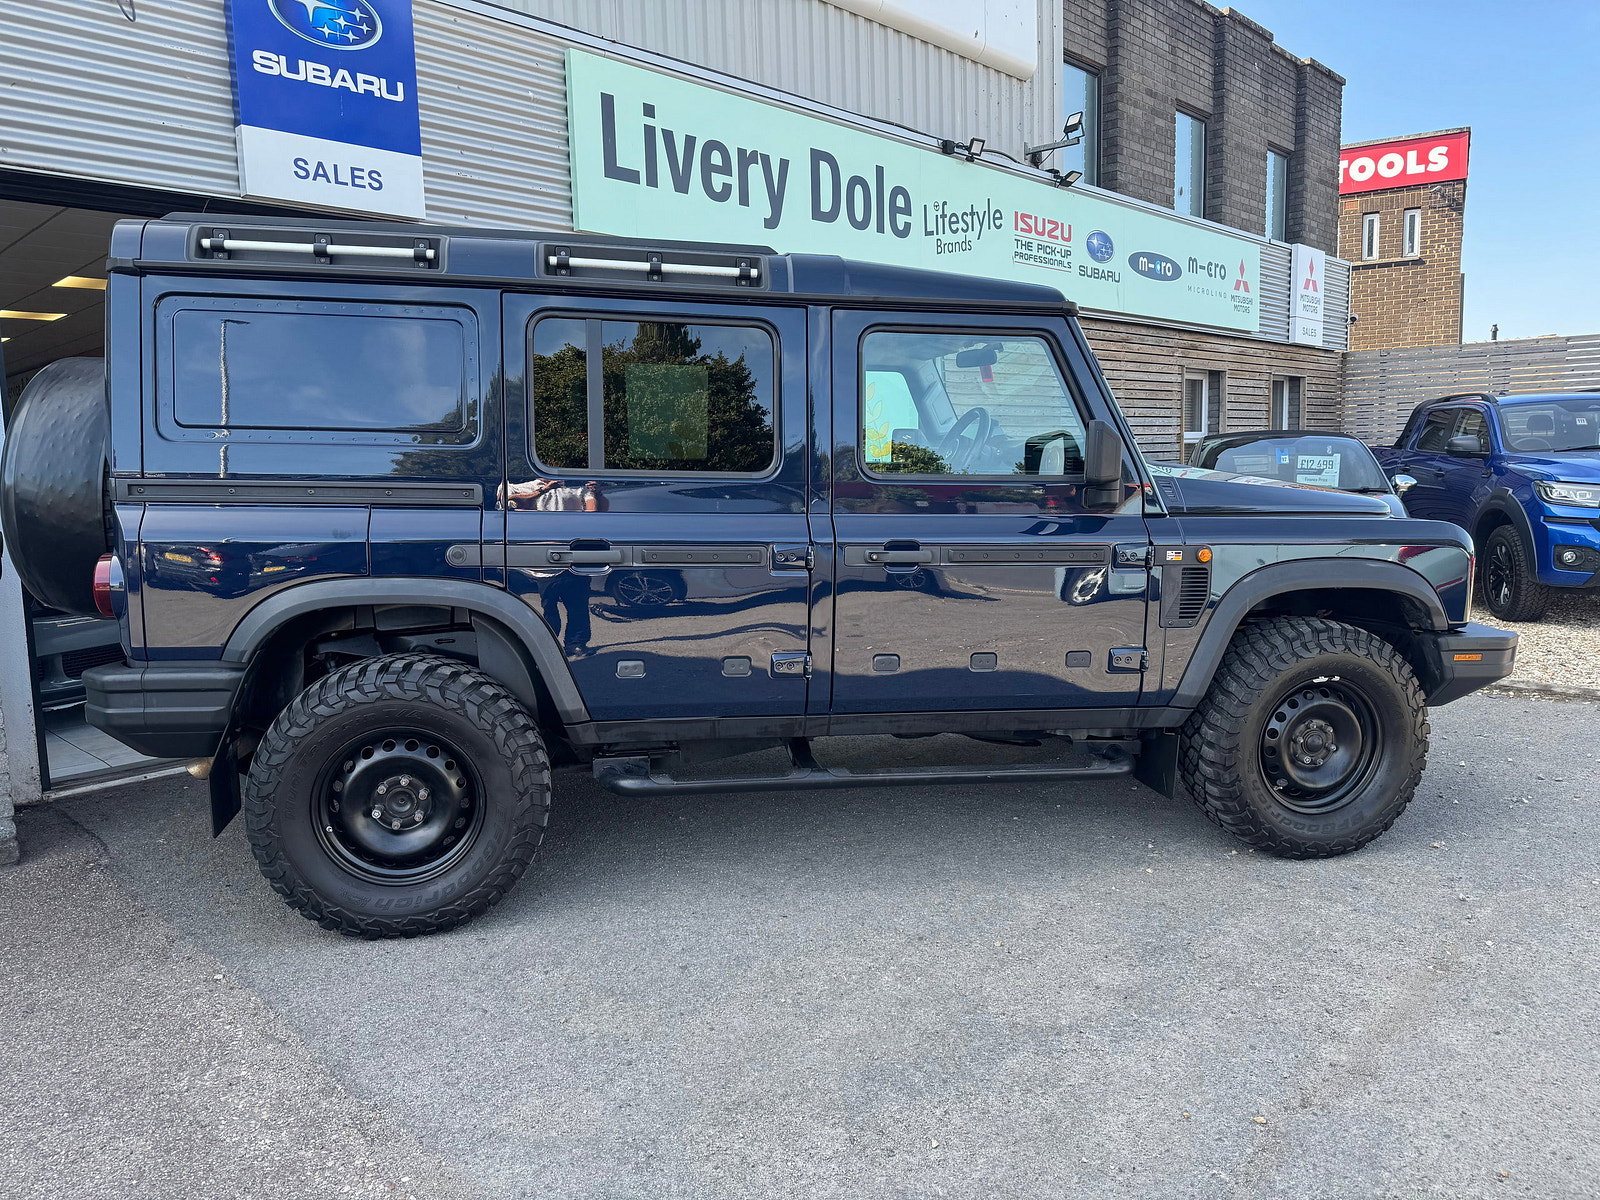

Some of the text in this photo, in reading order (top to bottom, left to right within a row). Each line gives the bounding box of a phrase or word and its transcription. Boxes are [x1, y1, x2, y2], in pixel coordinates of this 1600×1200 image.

[252, 49, 405, 102] SUBARU
[293, 156, 384, 192] SALES
[600, 92, 912, 239] Livery Dole
[923, 198, 1003, 240] Lifestyle
[1014, 210, 1072, 243] ISUZU
[936, 235, 972, 255] Brands
[1014, 238, 1072, 259] THE PICK-UP
[1014, 251, 1072, 269] PROFESSIONALS
[1078, 264, 1121, 283] SUBARU
[1230, 294, 1254, 305] MITSUBISHI
[1233, 303, 1250, 314] MOTORS
[1301, 326, 1317, 338] SALES
